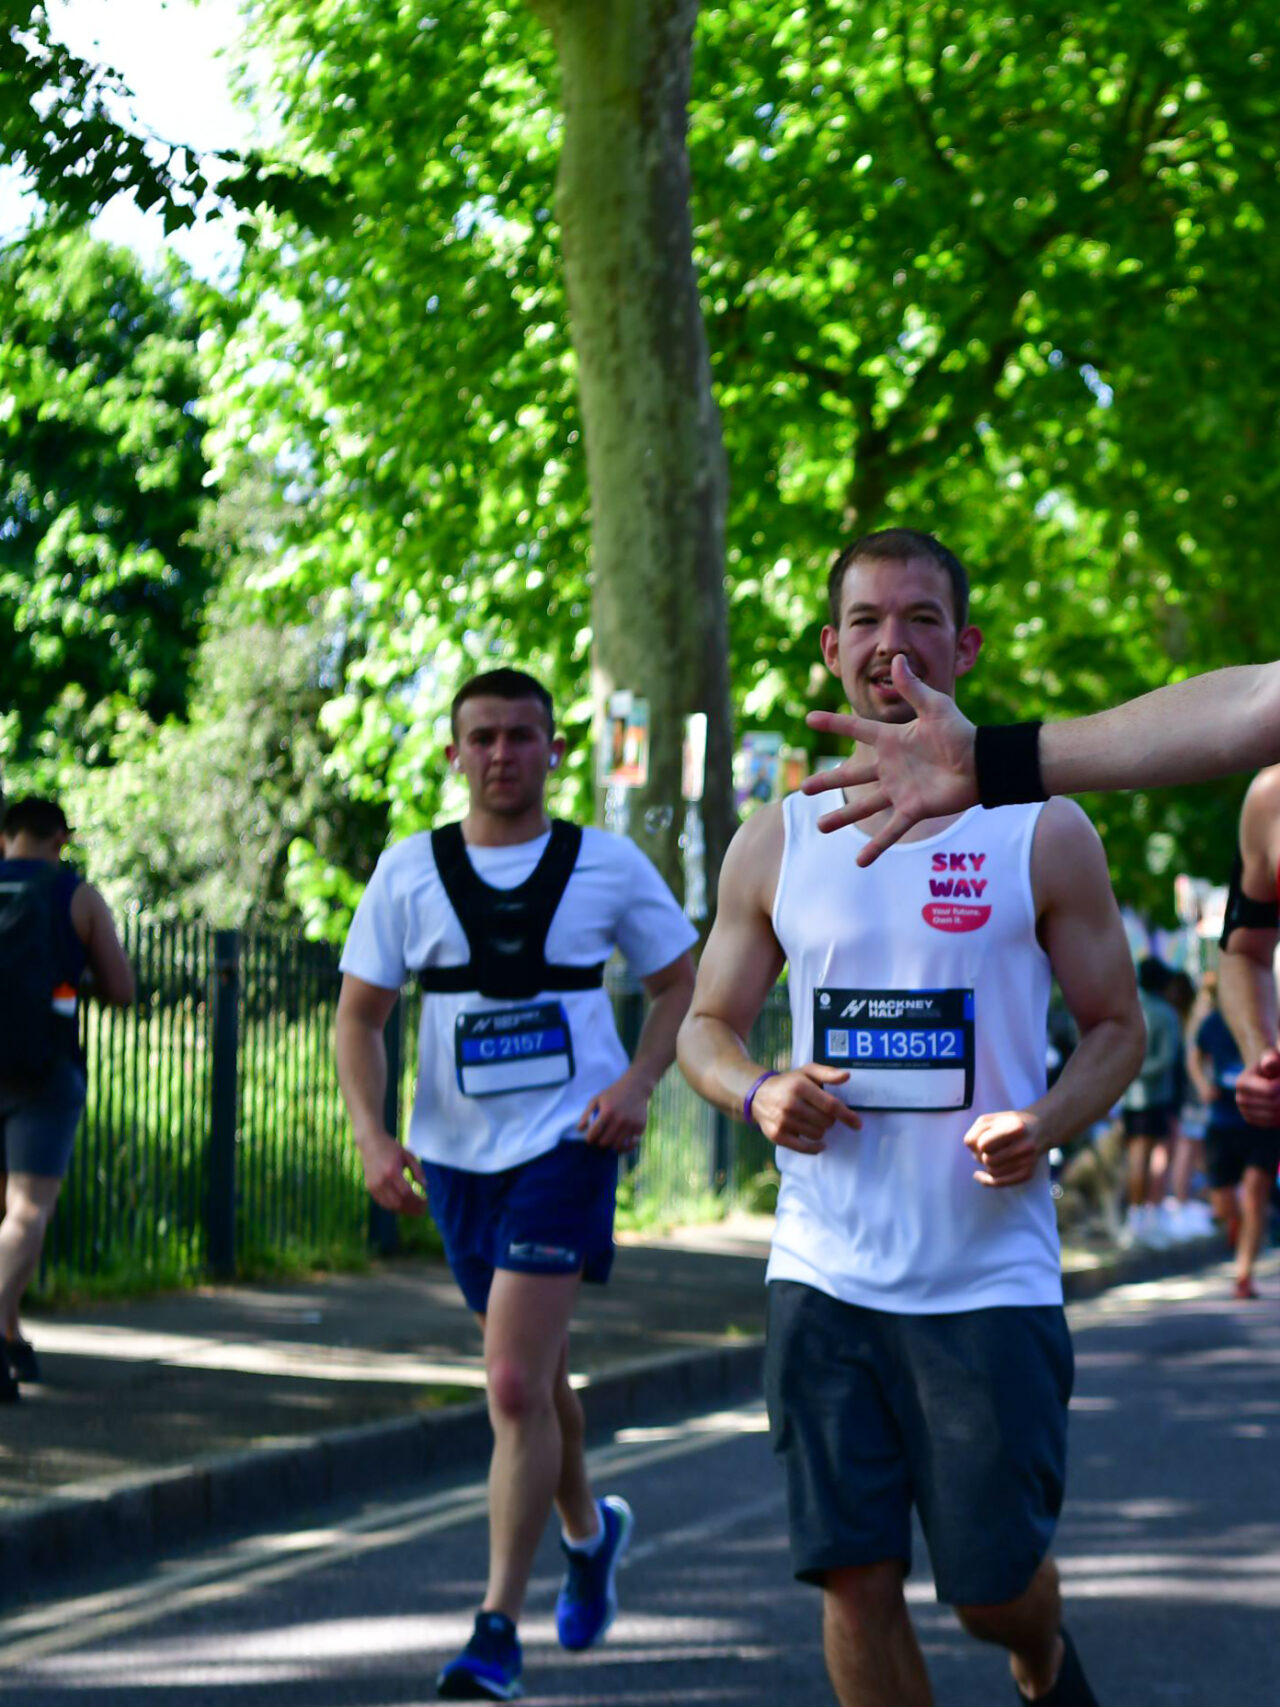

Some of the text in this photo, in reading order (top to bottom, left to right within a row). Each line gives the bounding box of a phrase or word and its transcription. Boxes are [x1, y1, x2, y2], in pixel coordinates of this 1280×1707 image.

[931, 852, 986, 872] SKY
[928, 878, 988, 898] WAY
[868, 999, 934, 1009] HACKNEY
[868, 1009, 904, 1018] HALF
[480, 1037, 496, 1058] C
[856, 1031, 956, 1058] B 13512
